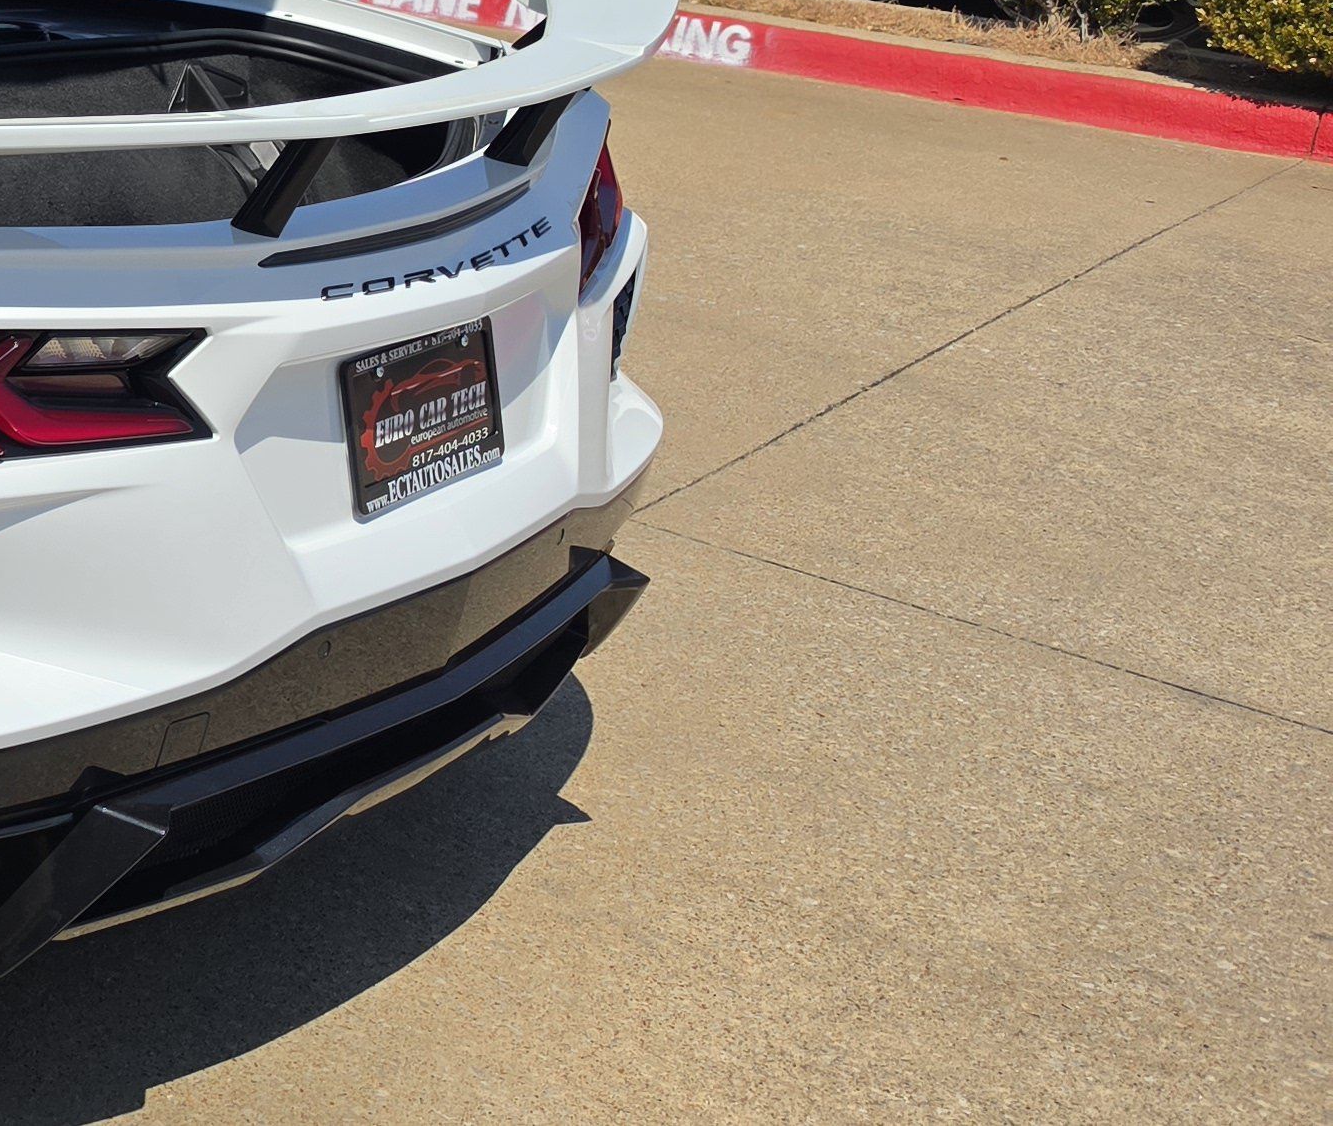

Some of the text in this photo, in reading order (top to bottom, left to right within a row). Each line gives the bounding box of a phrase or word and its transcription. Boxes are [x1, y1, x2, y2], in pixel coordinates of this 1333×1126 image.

[320, 215, 553, 302] CORVETTE
[355, 356, 383, 373] SALES
[388, 340, 423, 362] SERVICE
[375, 381, 487, 448] EURO CAR TECH
[411, 407, 488, 446] european automotive
[412, 426, 489, 467] 817-404-4033
[366, 445, 501, 514] www.ECTAUTOSALES.com
